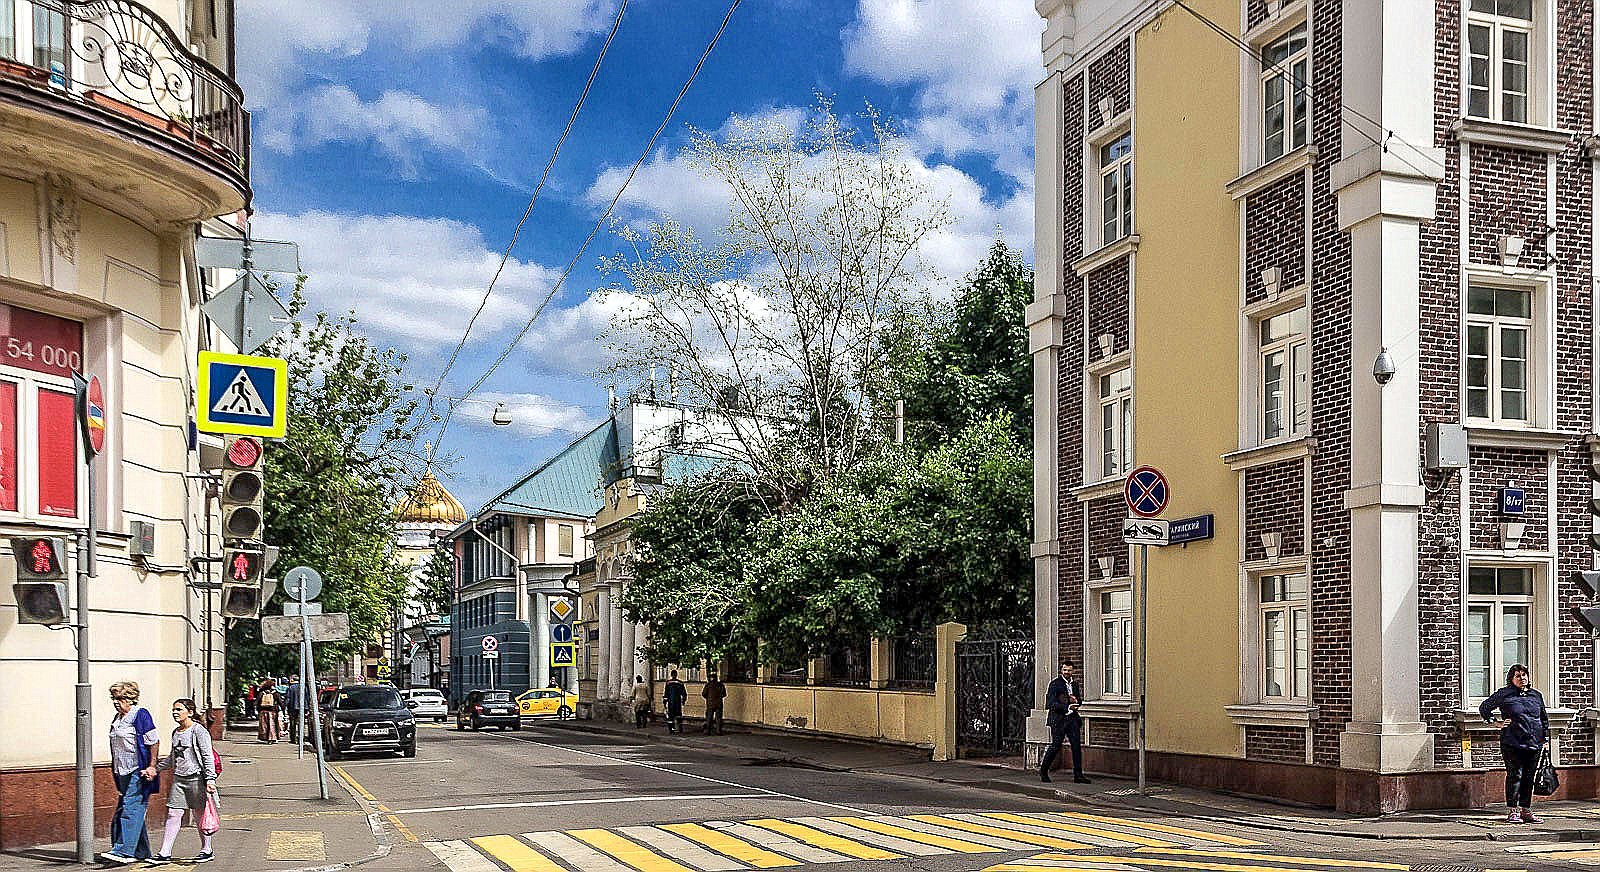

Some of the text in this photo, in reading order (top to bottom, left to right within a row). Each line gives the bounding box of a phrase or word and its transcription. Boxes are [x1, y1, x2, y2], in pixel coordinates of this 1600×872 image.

[7, 337, 80, 369] 54 000
[1169, 520, 1200, 534] АРИНСКИЙ
